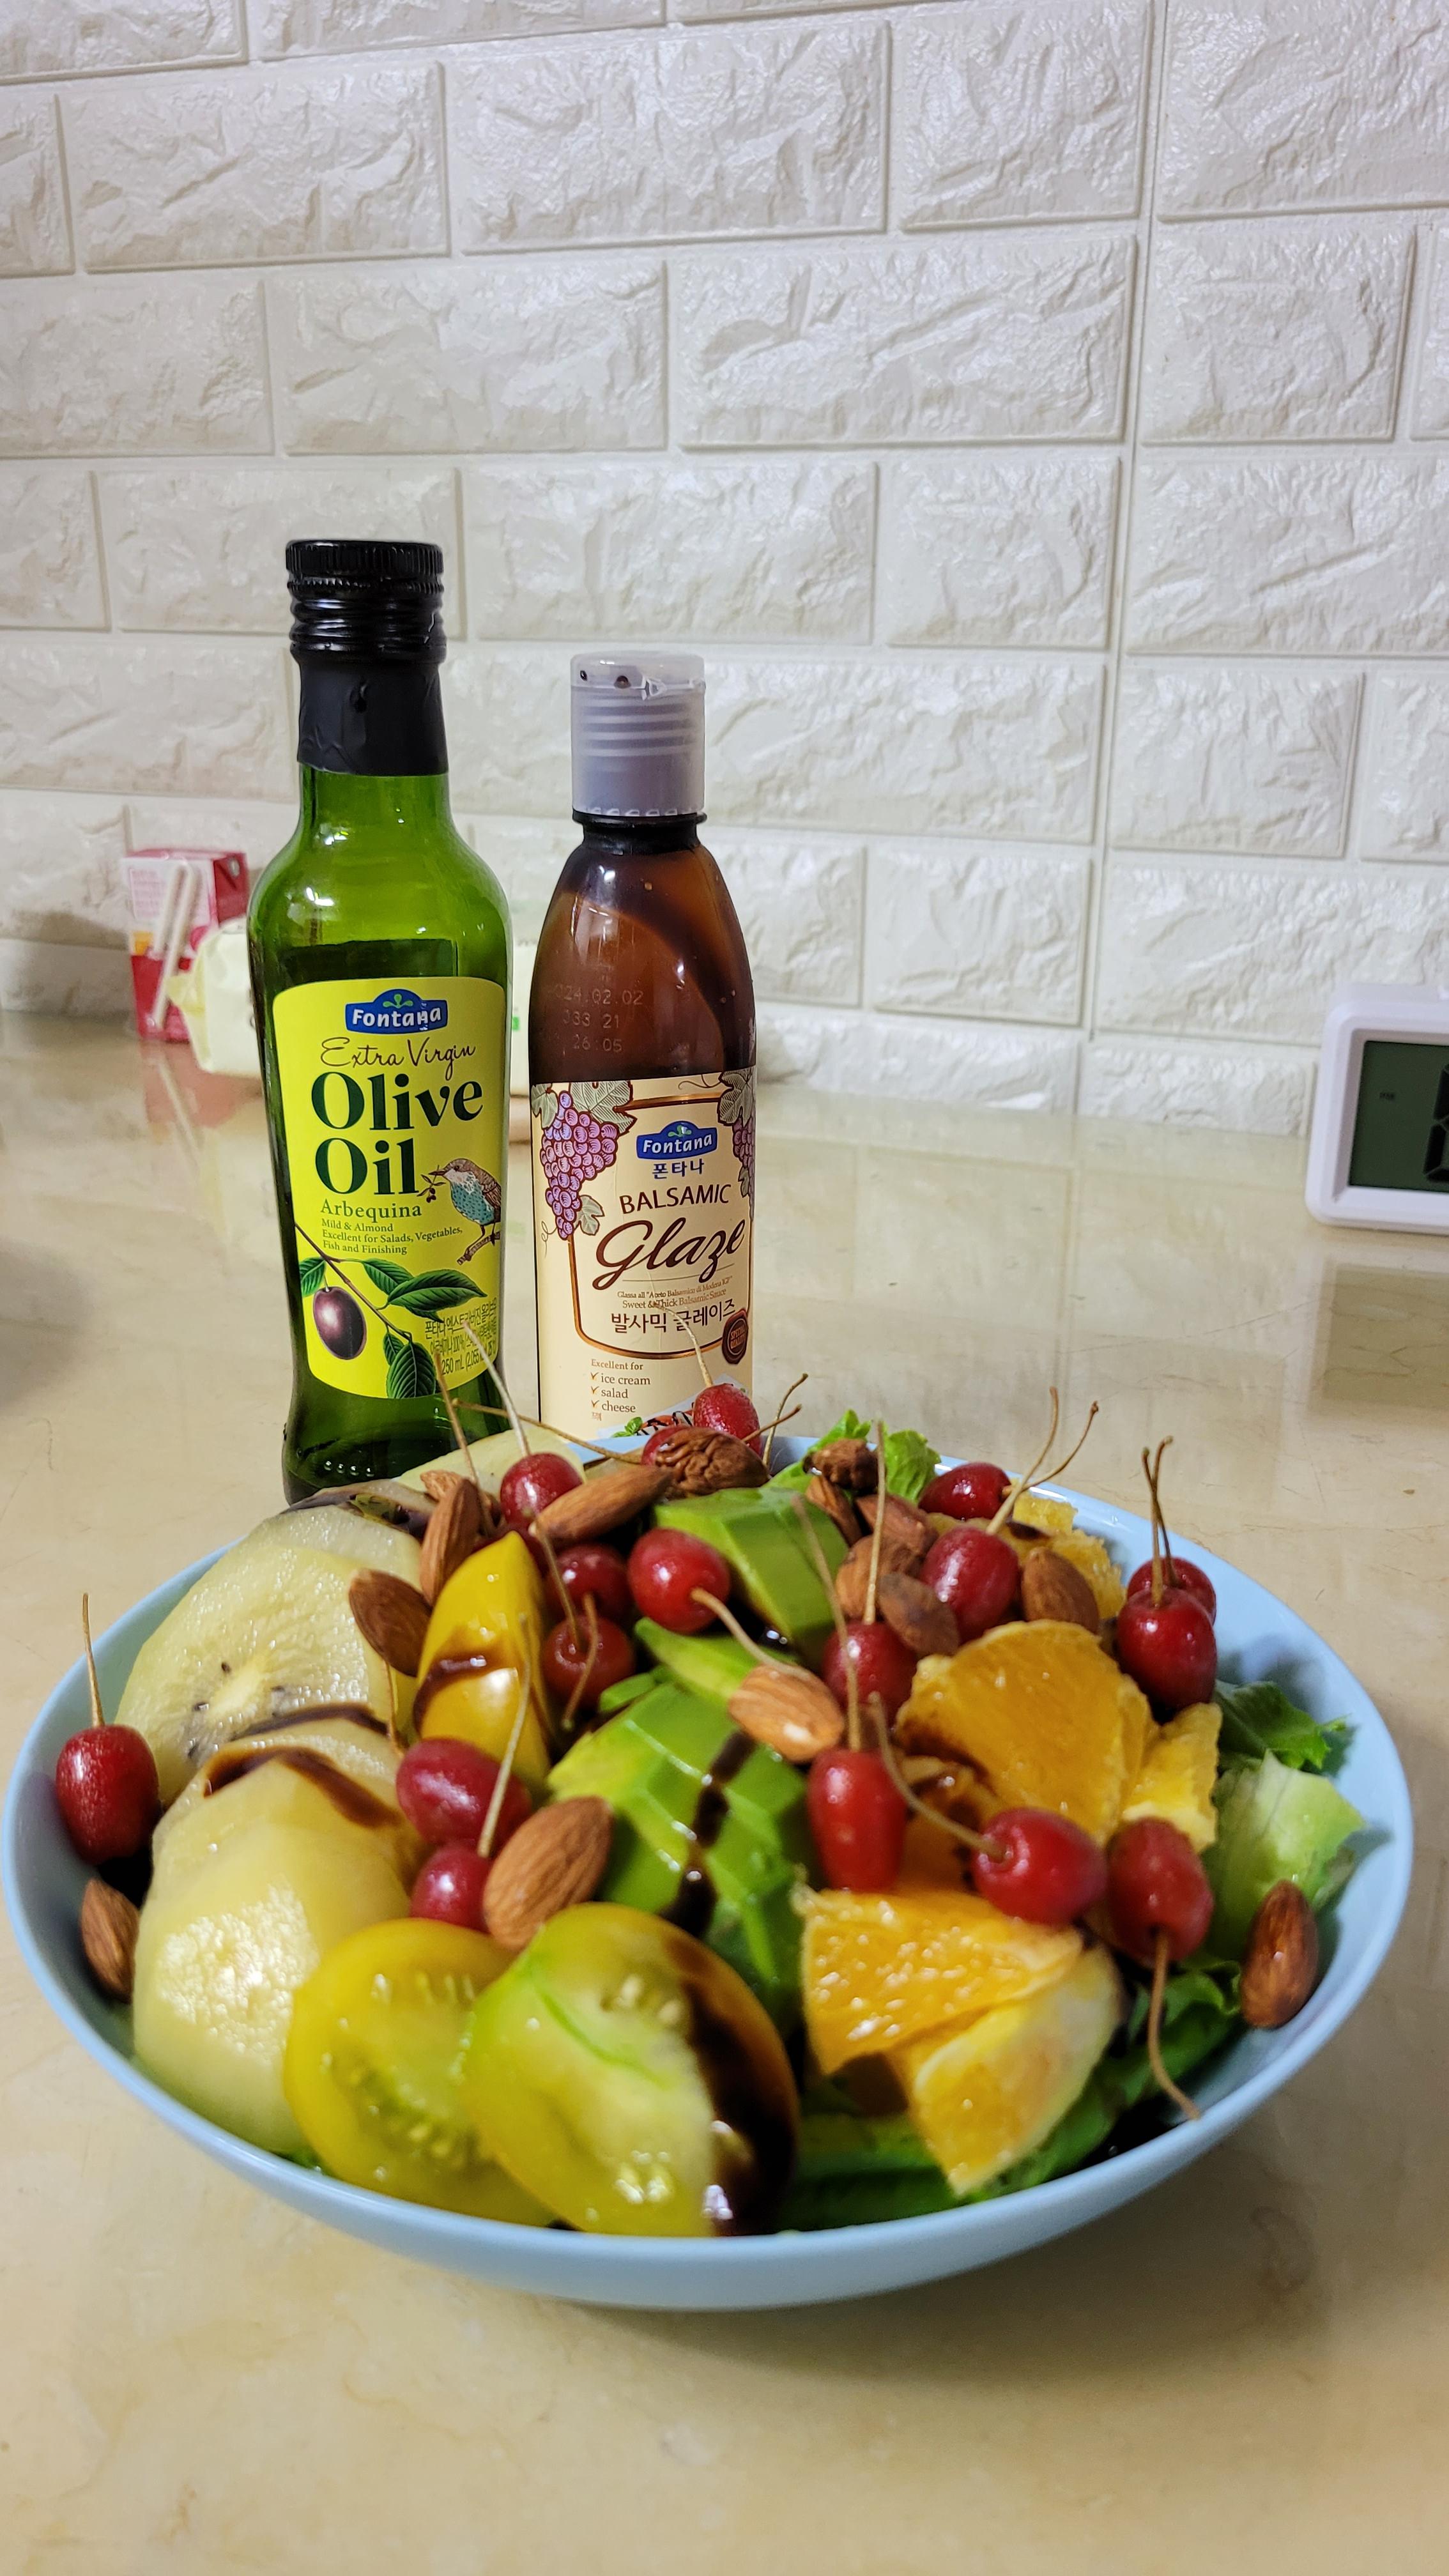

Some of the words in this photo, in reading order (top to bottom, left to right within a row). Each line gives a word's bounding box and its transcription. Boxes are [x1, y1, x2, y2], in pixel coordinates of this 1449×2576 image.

[352, 1006, 442, 1027] Fontana
[321, 1037, 404, 1068] Extra
[408, 1037, 476, 1080] Virgin
[311, 1071, 484, 1131] Olive
[643, 1133, 712, 1154] Fontana
[314, 1137, 420, 1196] Oil
[652, 1158, 705, 1179] 폰타나
[619, 1184, 732, 1215] BALSAMIC
[320, 1199, 422, 1223] Arbequina
[321, 1218, 342, 1230] Mild
[344, 1222, 352, 1230] &
[354, 1223, 394, 1232] Almond
[322, 1229, 361, 1242] Excellent
[364, 1234, 378, 1243] for
[380, 1233, 413, 1243] Salads,
[415, 1225, 463, 1241] Vegetables,
[323, 1239, 341, 1250] Fish
[342, 1244, 359, 1253] and
[362, 1245, 408, 1255] Finishing
[592, 1217, 746, 1291] Glaze
[622, 1300, 646, 1308] Sweet
[656, 1300, 678, 1308] Thick
[679, 1293, 709, 1305] Balsamic
[611, 1312, 667, 1334] 발사믹
[673, 1298, 736, 1332] 글레이즈
[591, 1358, 629, 1370] Excellent
[630, 1361, 644, 1370] for
[601, 1373, 615, 1384] ice
[618, 1377, 651, 1385] cream
[601, 1388, 629, 1399] salad
[601, 1400, 636, 1413] cheese
